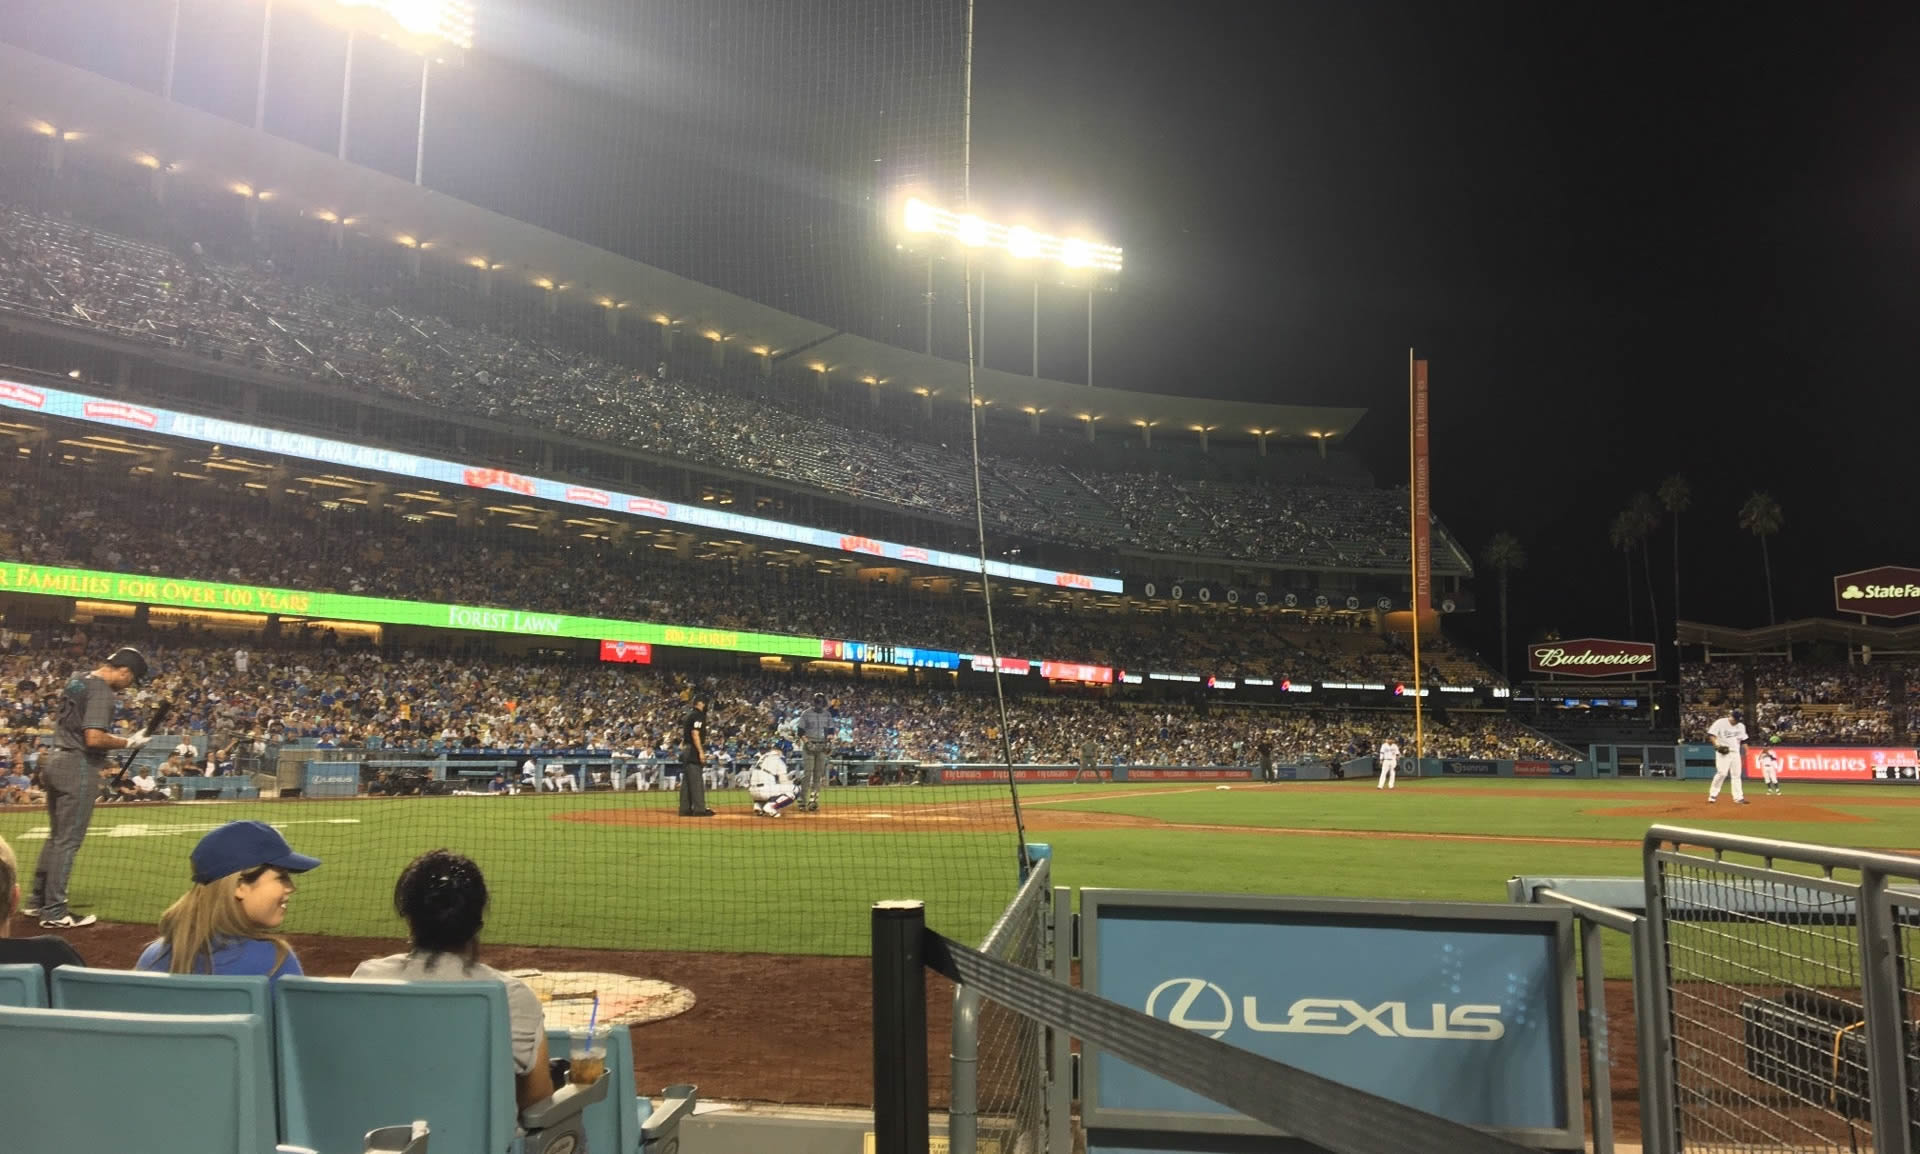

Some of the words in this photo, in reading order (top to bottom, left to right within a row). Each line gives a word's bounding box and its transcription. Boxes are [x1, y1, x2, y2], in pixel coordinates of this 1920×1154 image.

[223, 587, 252, 606] 100
[1534, 648, 1652, 667] Budweiser
[1754, 754, 1784, 772] Fy
[1787, 752, 1867, 771] Emirates
[1243, 996, 1505, 1041] LEXUS
